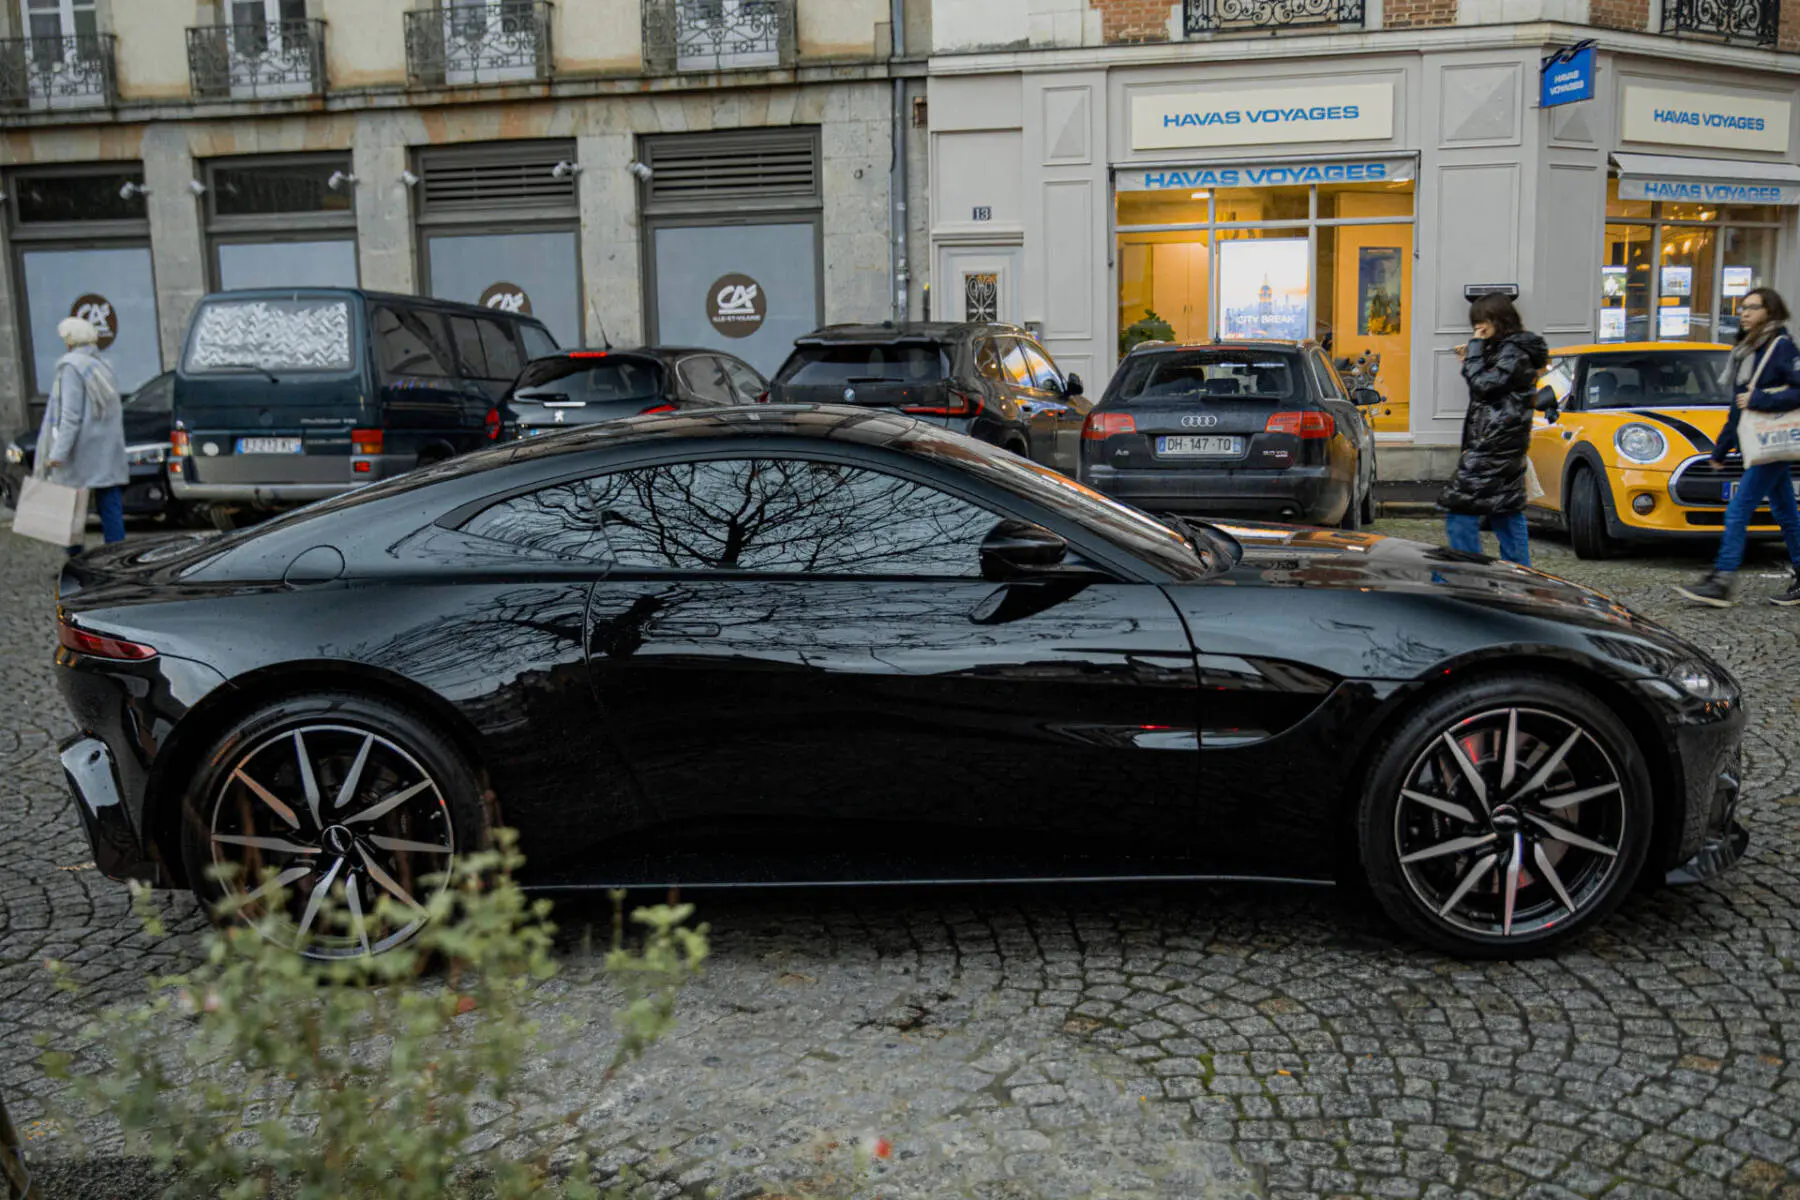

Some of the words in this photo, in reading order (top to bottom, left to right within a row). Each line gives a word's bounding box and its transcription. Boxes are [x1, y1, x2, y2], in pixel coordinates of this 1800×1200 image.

[1554, 70, 1580, 84] HAVAS
[1549, 80, 1584, 96] VOYAGES
[1163, 110, 1241, 128] HAVAS
[1246, 105, 1360, 124] VOYAGES
[1653, 109, 1700, 126] HAVAS
[1702, 113, 1765, 131] VOYAGES
[1144, 169, 1240, 188] HAVAS
[1245, 163, 1387, 185] VOYAGES
[1644, 182, 1701, 199] HAVAS
[1704, 185, 1781, 202] VOYAGES
[975, 208, 990, 220] 13
[1236, 315, 1259, 323] CITY
[1261, 314, 1296, 323] BREAK
